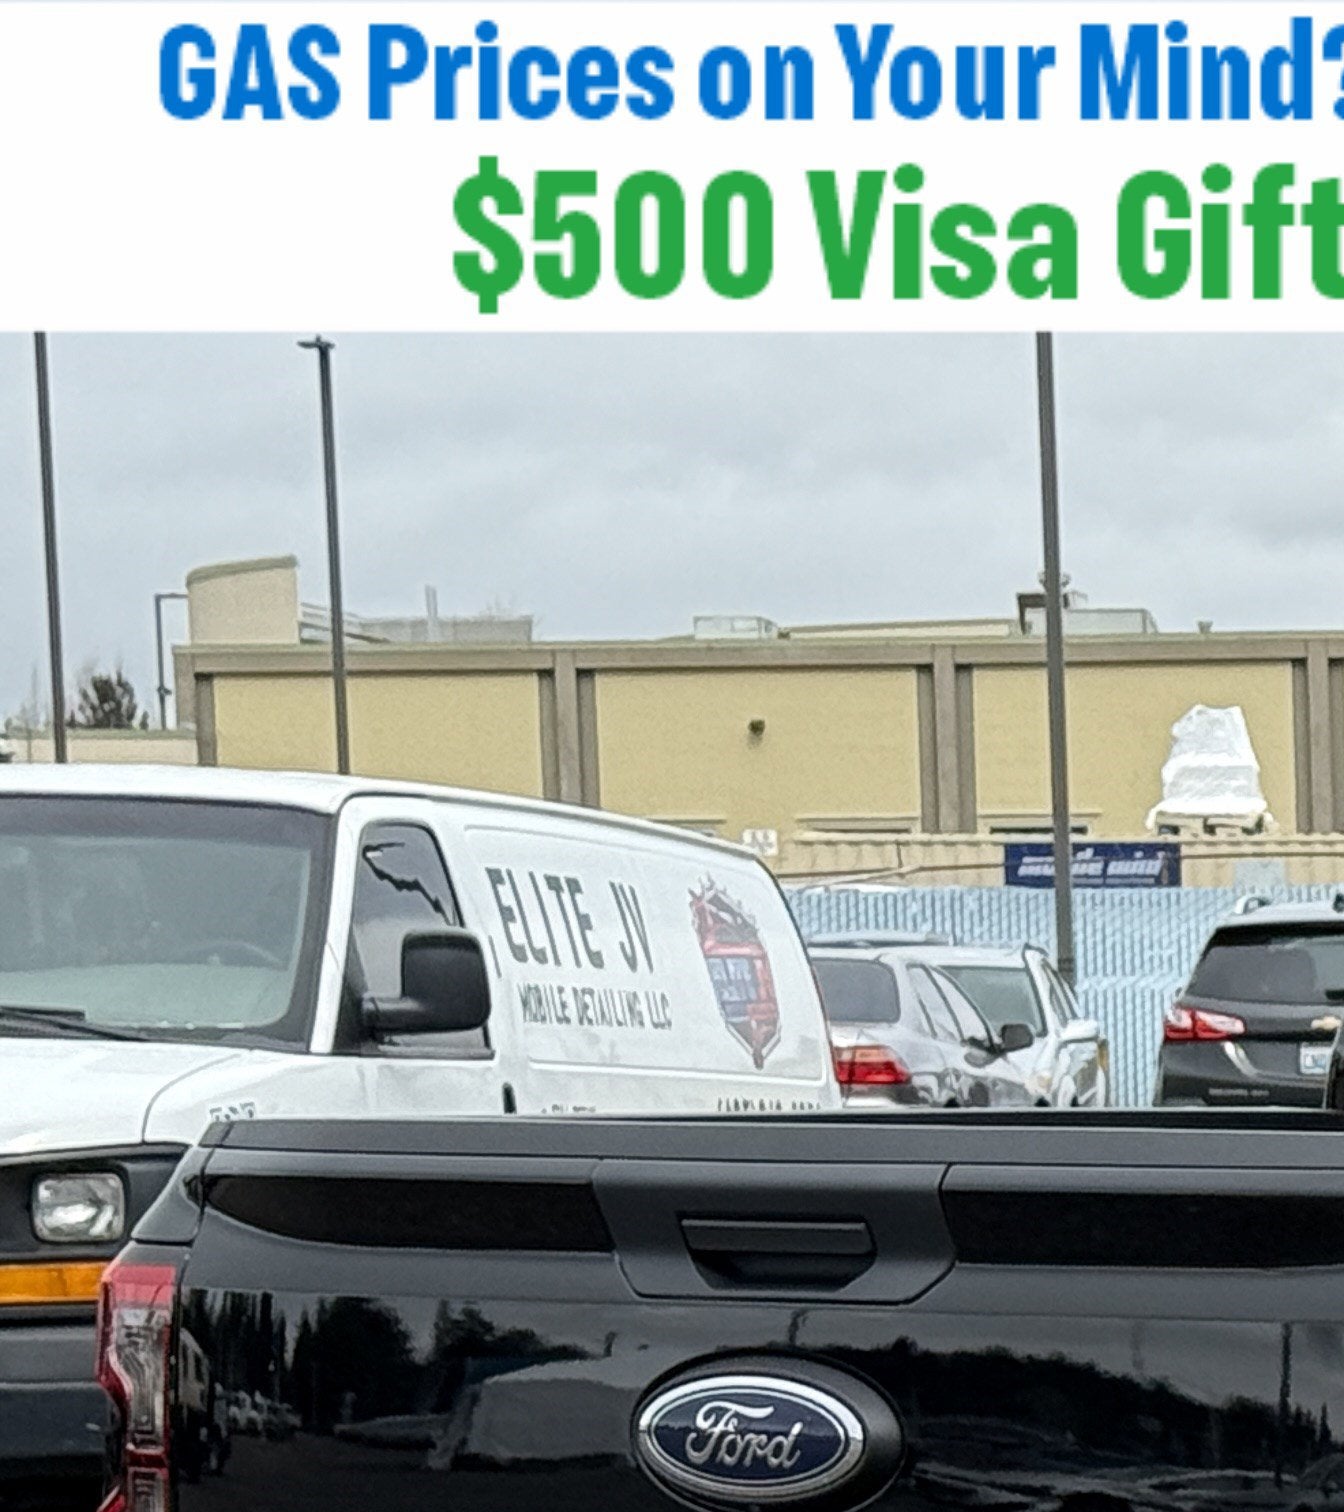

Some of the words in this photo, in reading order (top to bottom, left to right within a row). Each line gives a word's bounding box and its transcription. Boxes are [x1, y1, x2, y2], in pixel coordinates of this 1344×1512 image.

[485, 867, 604, 969] ELITE
[608, 879, 654, 975] JV
[517, 983, 571, 1025] MOBILE
[645, 989, 673, 1031] LLC
[685, 1401, 804, 1469] Ford
